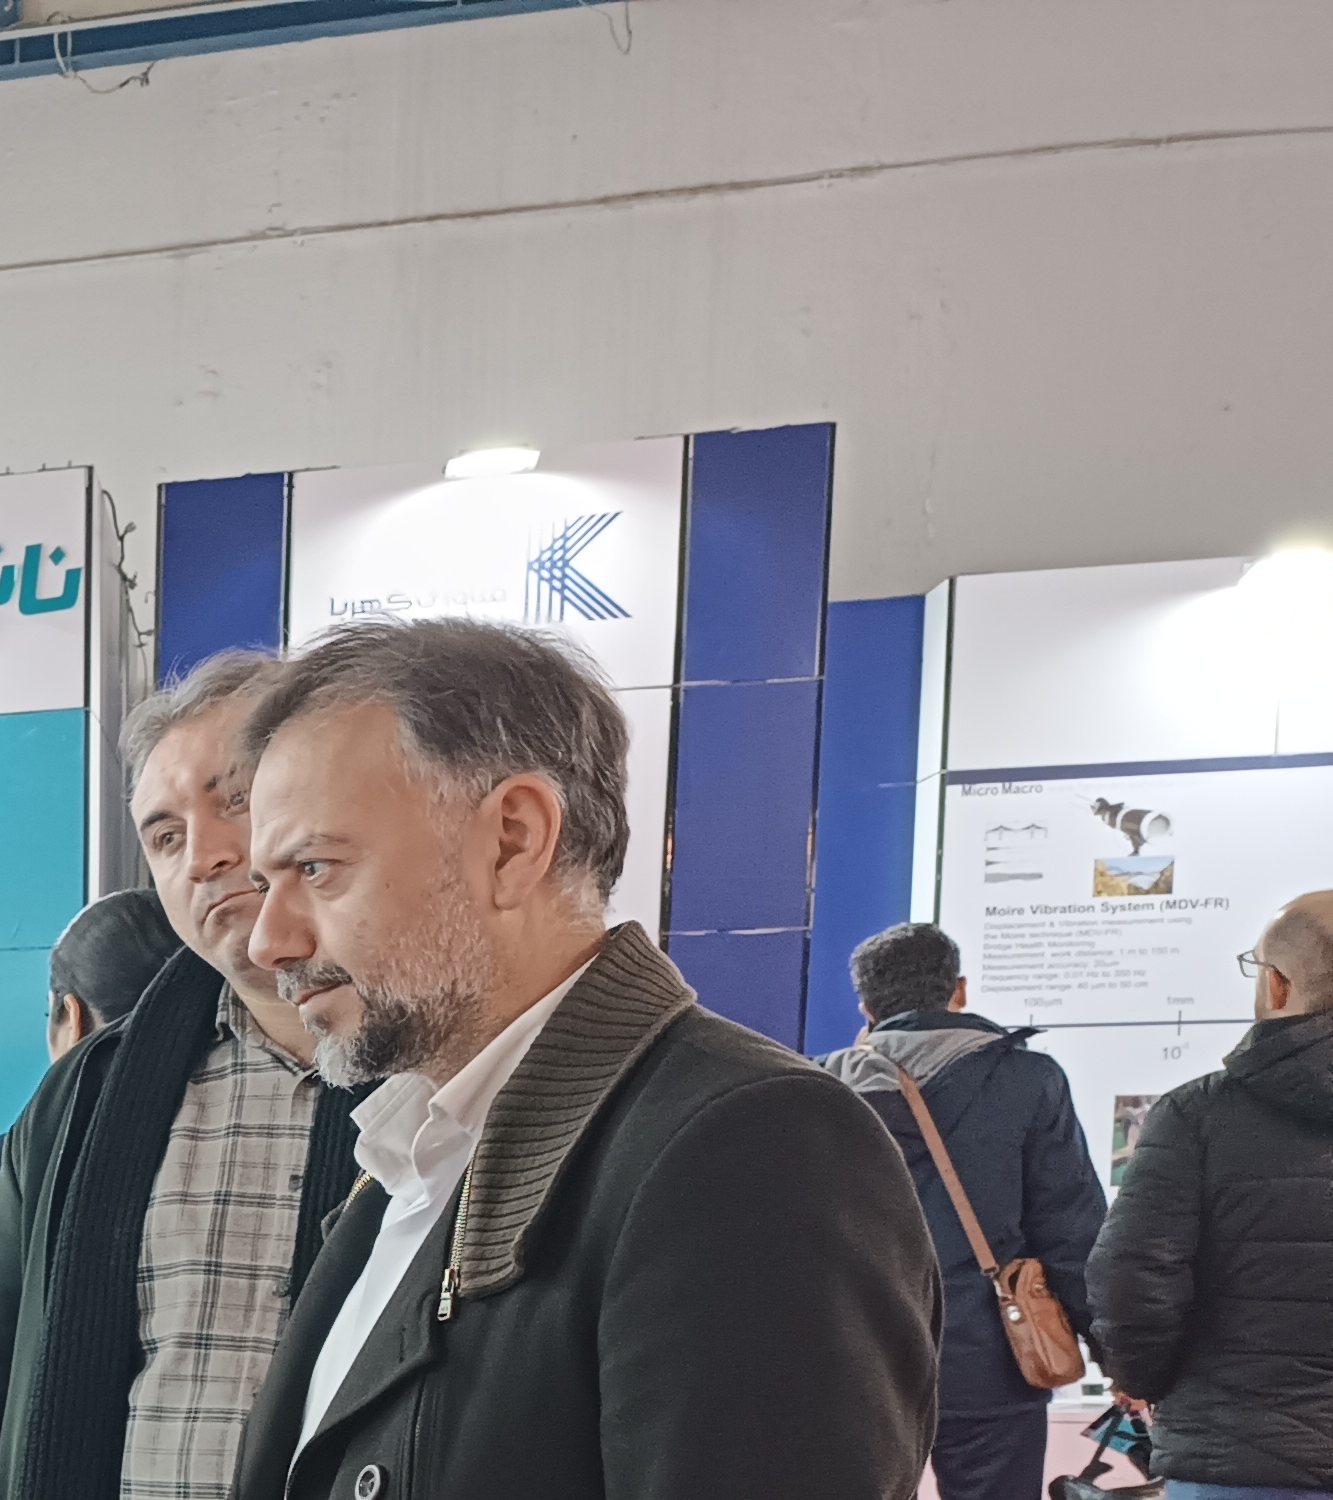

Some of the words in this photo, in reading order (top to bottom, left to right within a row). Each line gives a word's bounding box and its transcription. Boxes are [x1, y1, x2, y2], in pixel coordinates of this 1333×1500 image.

[961, 783, 999, 797] Micro
[1002, 782, 1043, 795] Macro
[985, 906, 1025, 917] Moire
[1030, 903, 1096, 915] Vibration
[1100, 900, 1155, 915] System
[1159, 897, 1230, 912] (MDV-FR)
